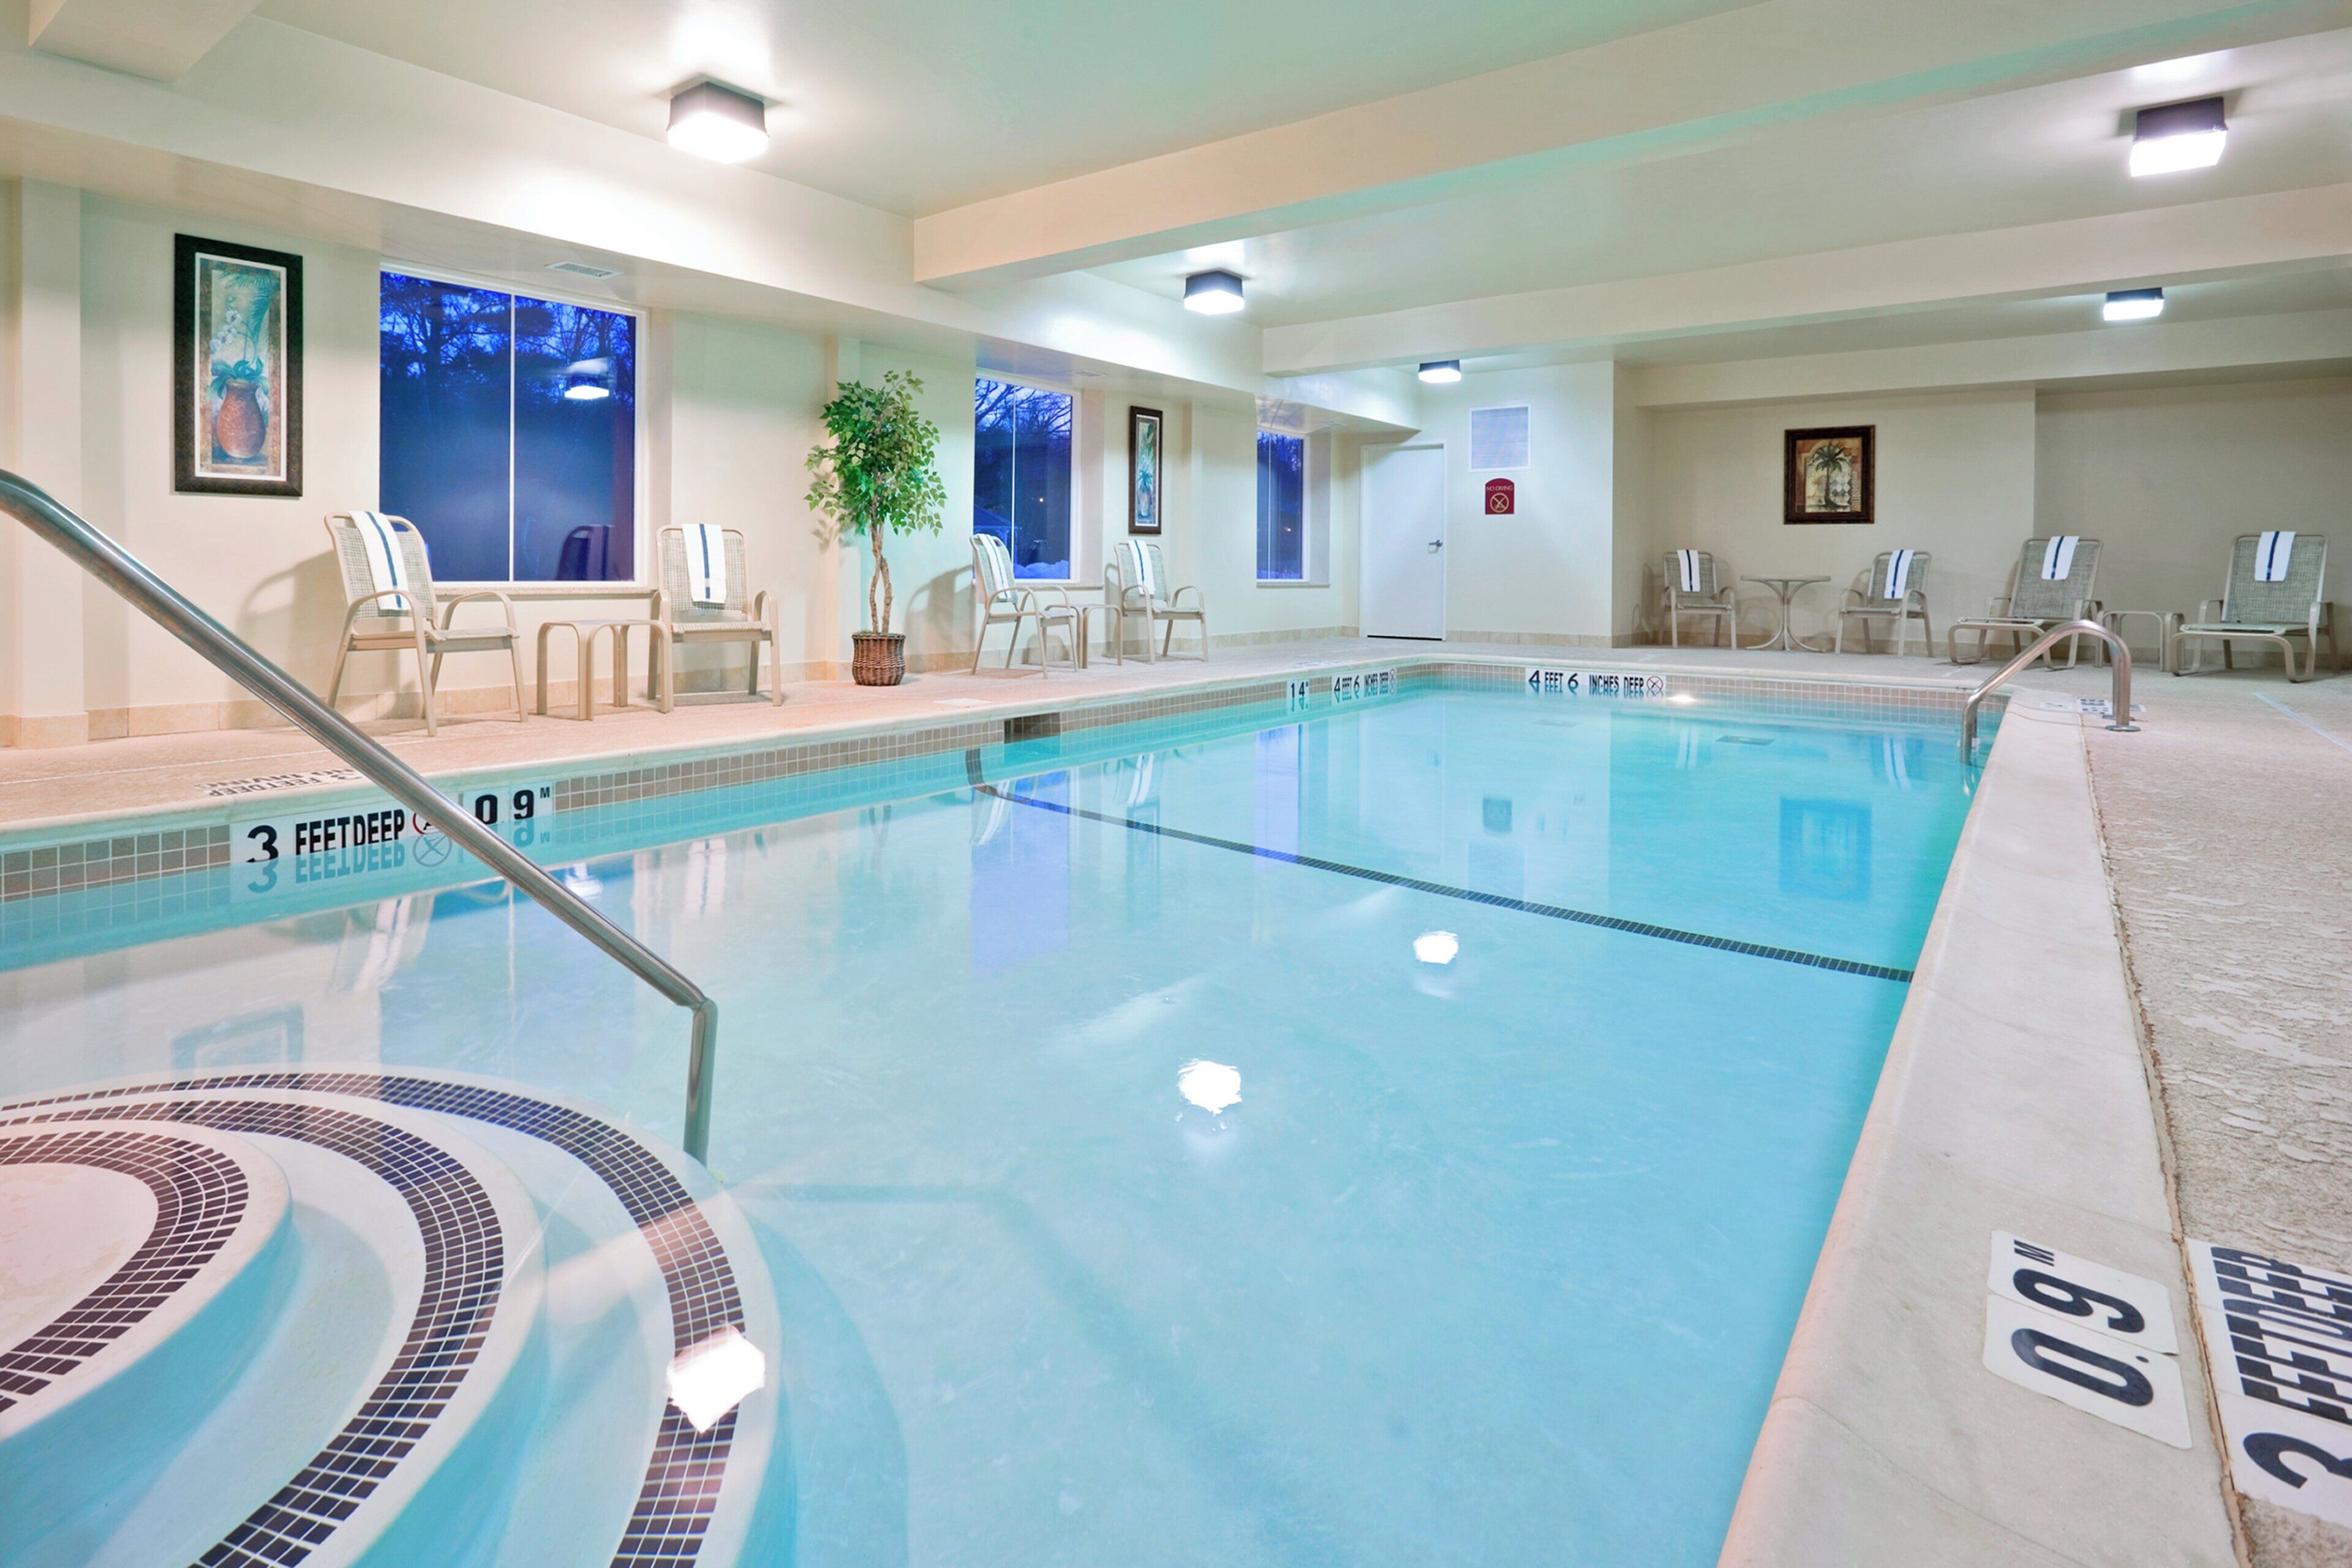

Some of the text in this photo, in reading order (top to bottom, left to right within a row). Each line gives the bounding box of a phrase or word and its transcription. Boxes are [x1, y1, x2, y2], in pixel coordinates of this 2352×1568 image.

[1334, 677, 1340, 691] 4
[1354, 675, 1360, 688] 6
[1529, 670, 1644, 690] 4 FEET 6 INCHES DEEP
[540, 786, 550, 799] M
[246, 824, 279, 863] 3
